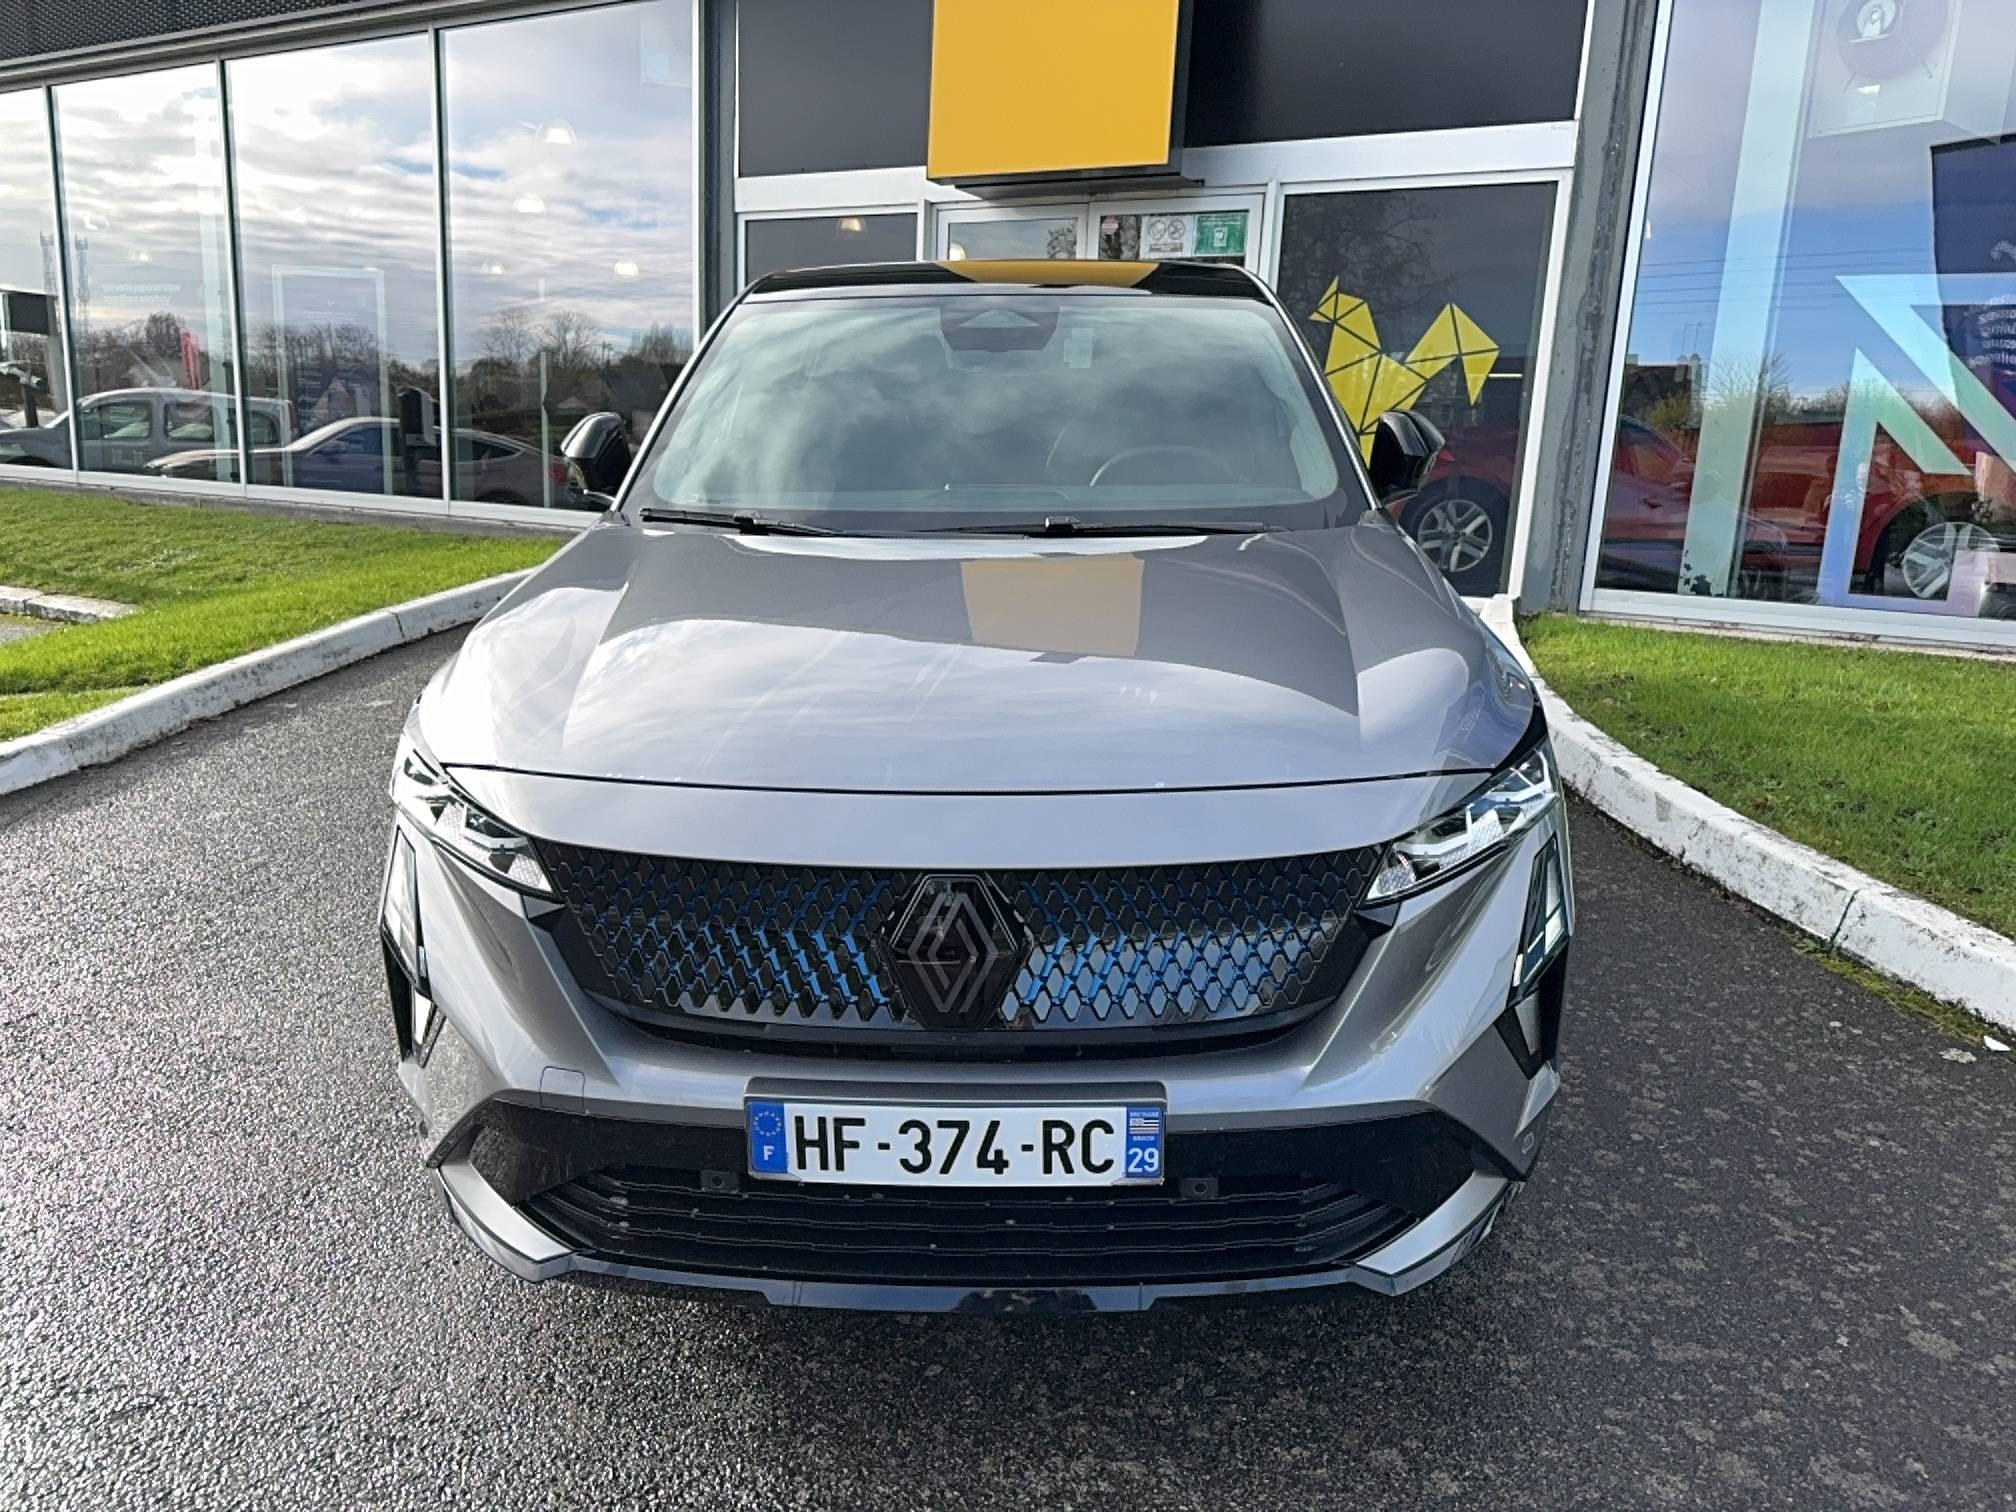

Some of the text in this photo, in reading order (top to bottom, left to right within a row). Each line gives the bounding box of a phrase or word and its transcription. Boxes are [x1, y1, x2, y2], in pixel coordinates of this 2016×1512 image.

[763, 1145, 775, 1161] F
[794, 1115, 1114, 1175] HF-374-RC
[1128, 1147, 1159, 1173] 29
